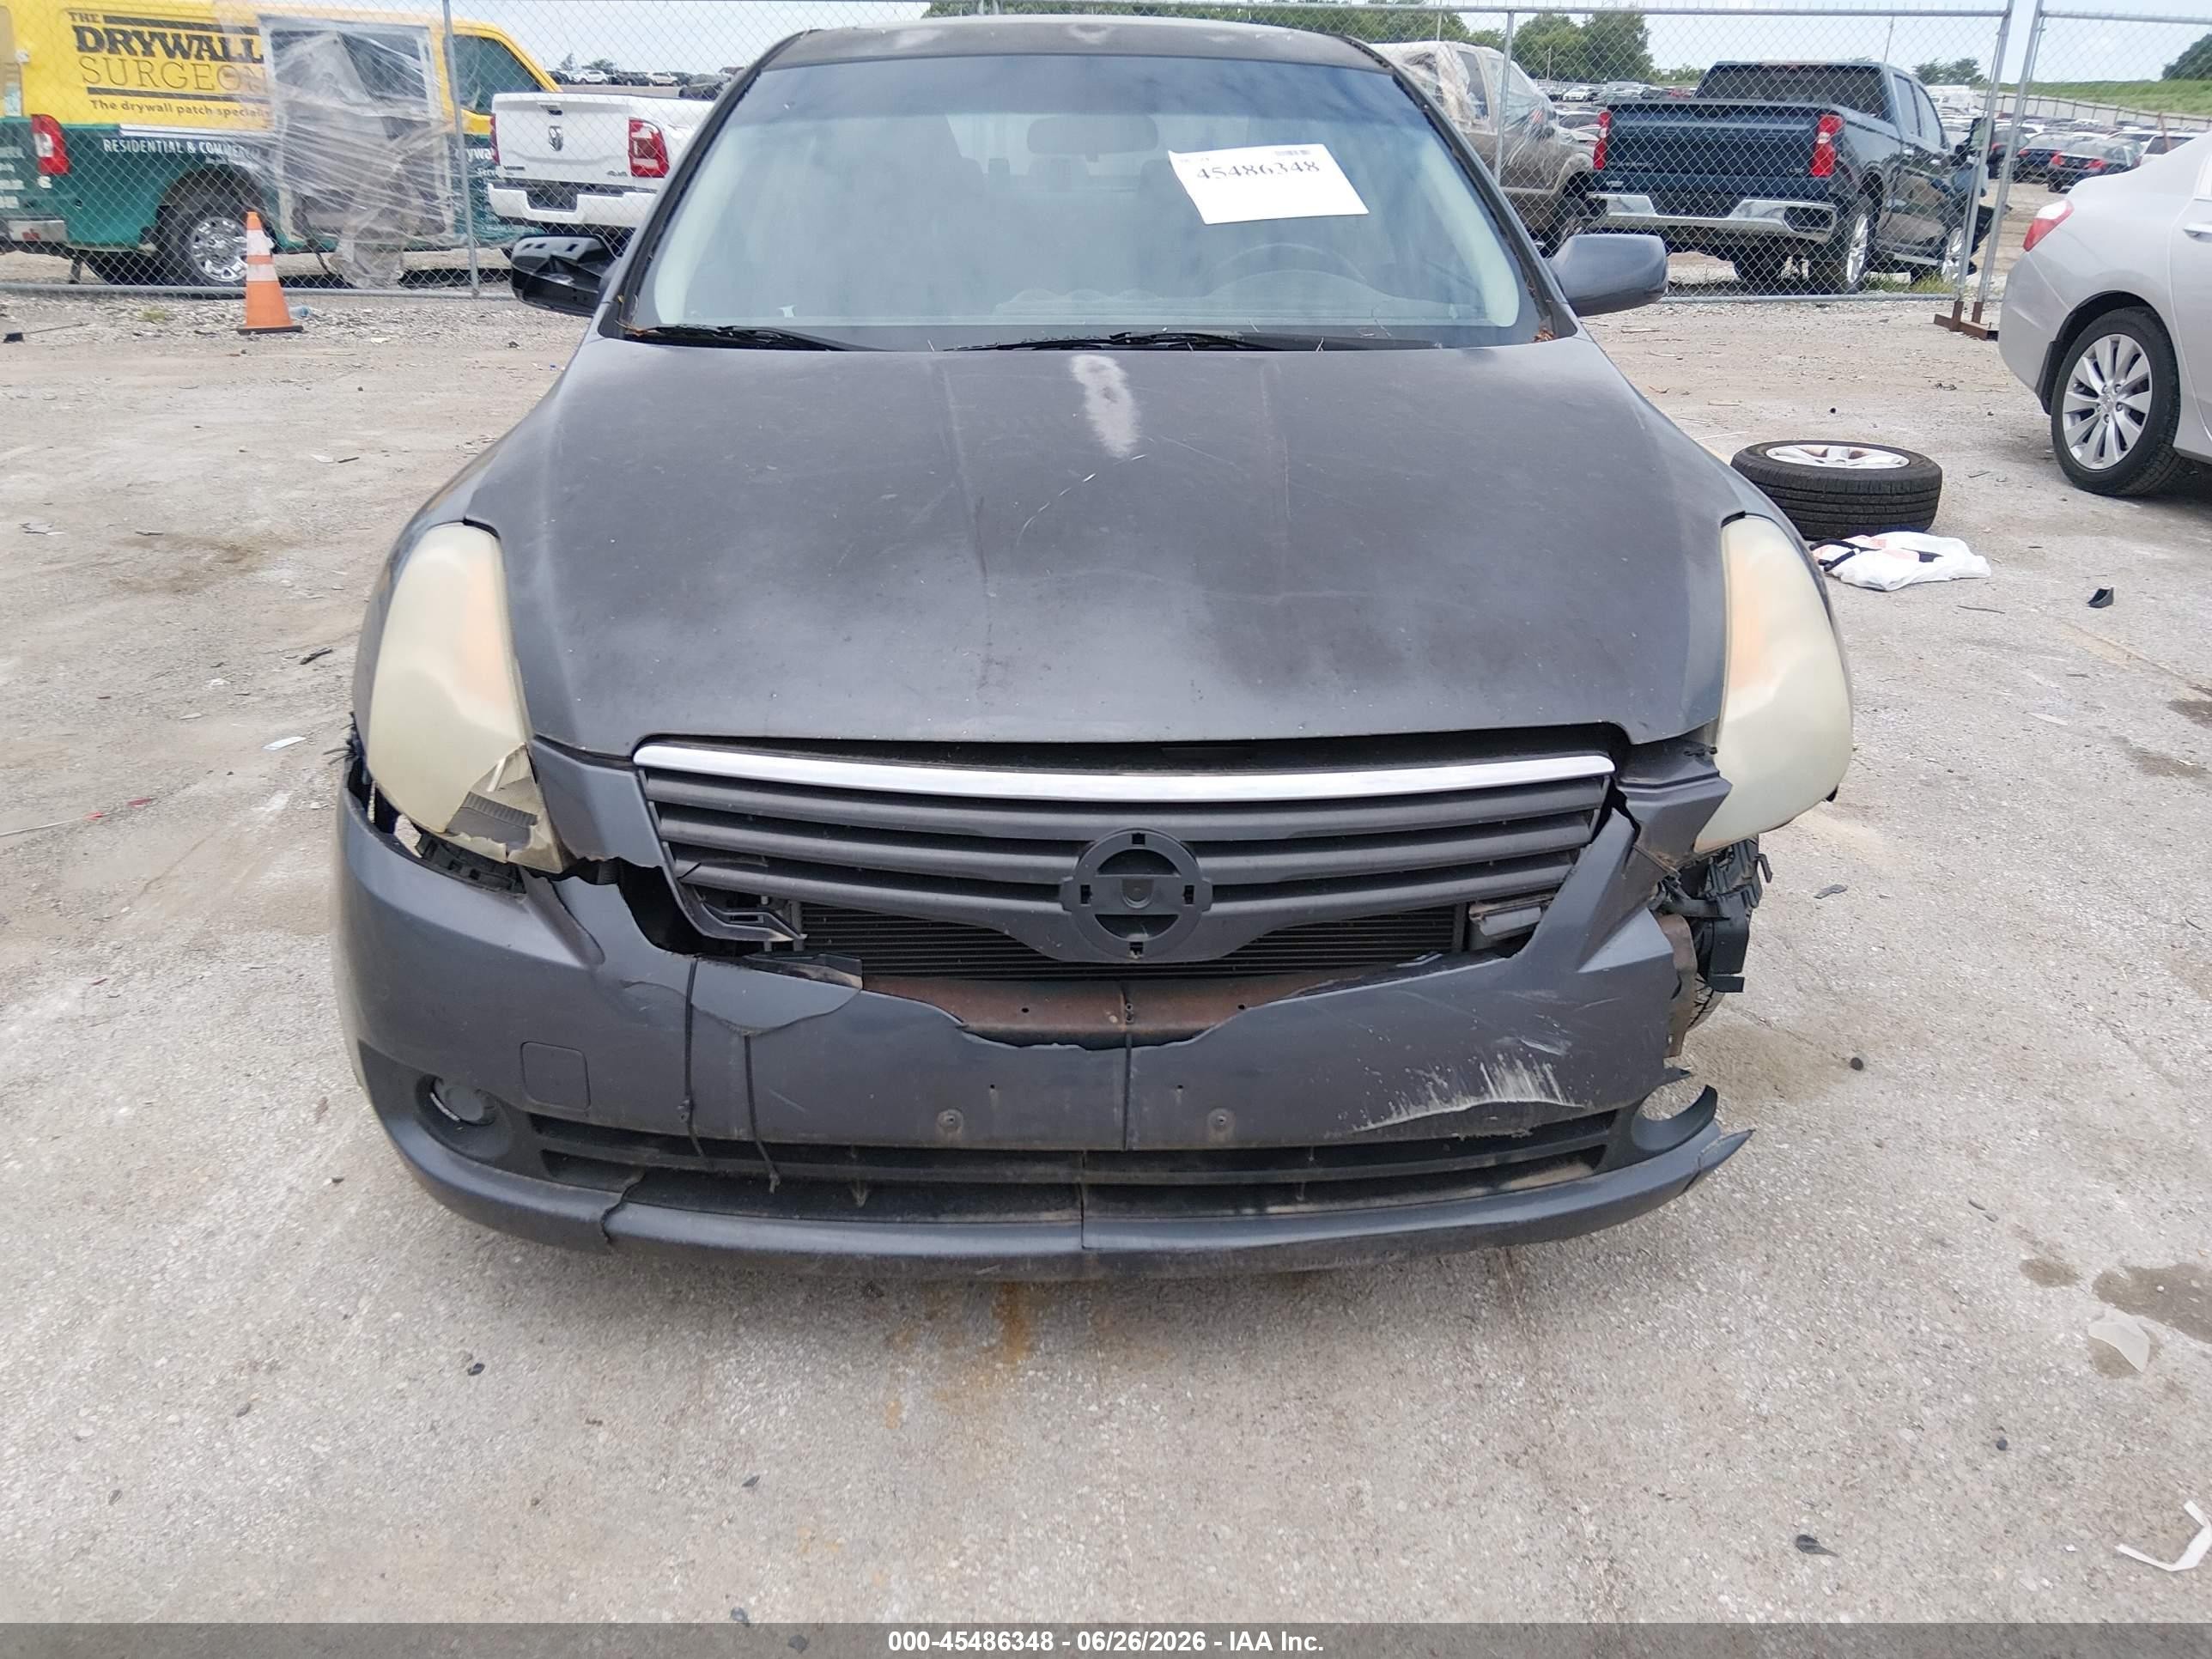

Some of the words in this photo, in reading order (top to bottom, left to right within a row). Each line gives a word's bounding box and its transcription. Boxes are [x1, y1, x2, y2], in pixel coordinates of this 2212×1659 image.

[69, 11, 101, 24] THE
[72, 24, 265, 64] DRYWALL
[90, 100, 118, 111] The
[121, 102, 172, 117] drywall
[176, 106, 214, 118] patch
[102, 138, 184, 154] RESIDENTIAL
[186, 141, 197, 155] &
[1197, 161, 1320, 179] 45486348
